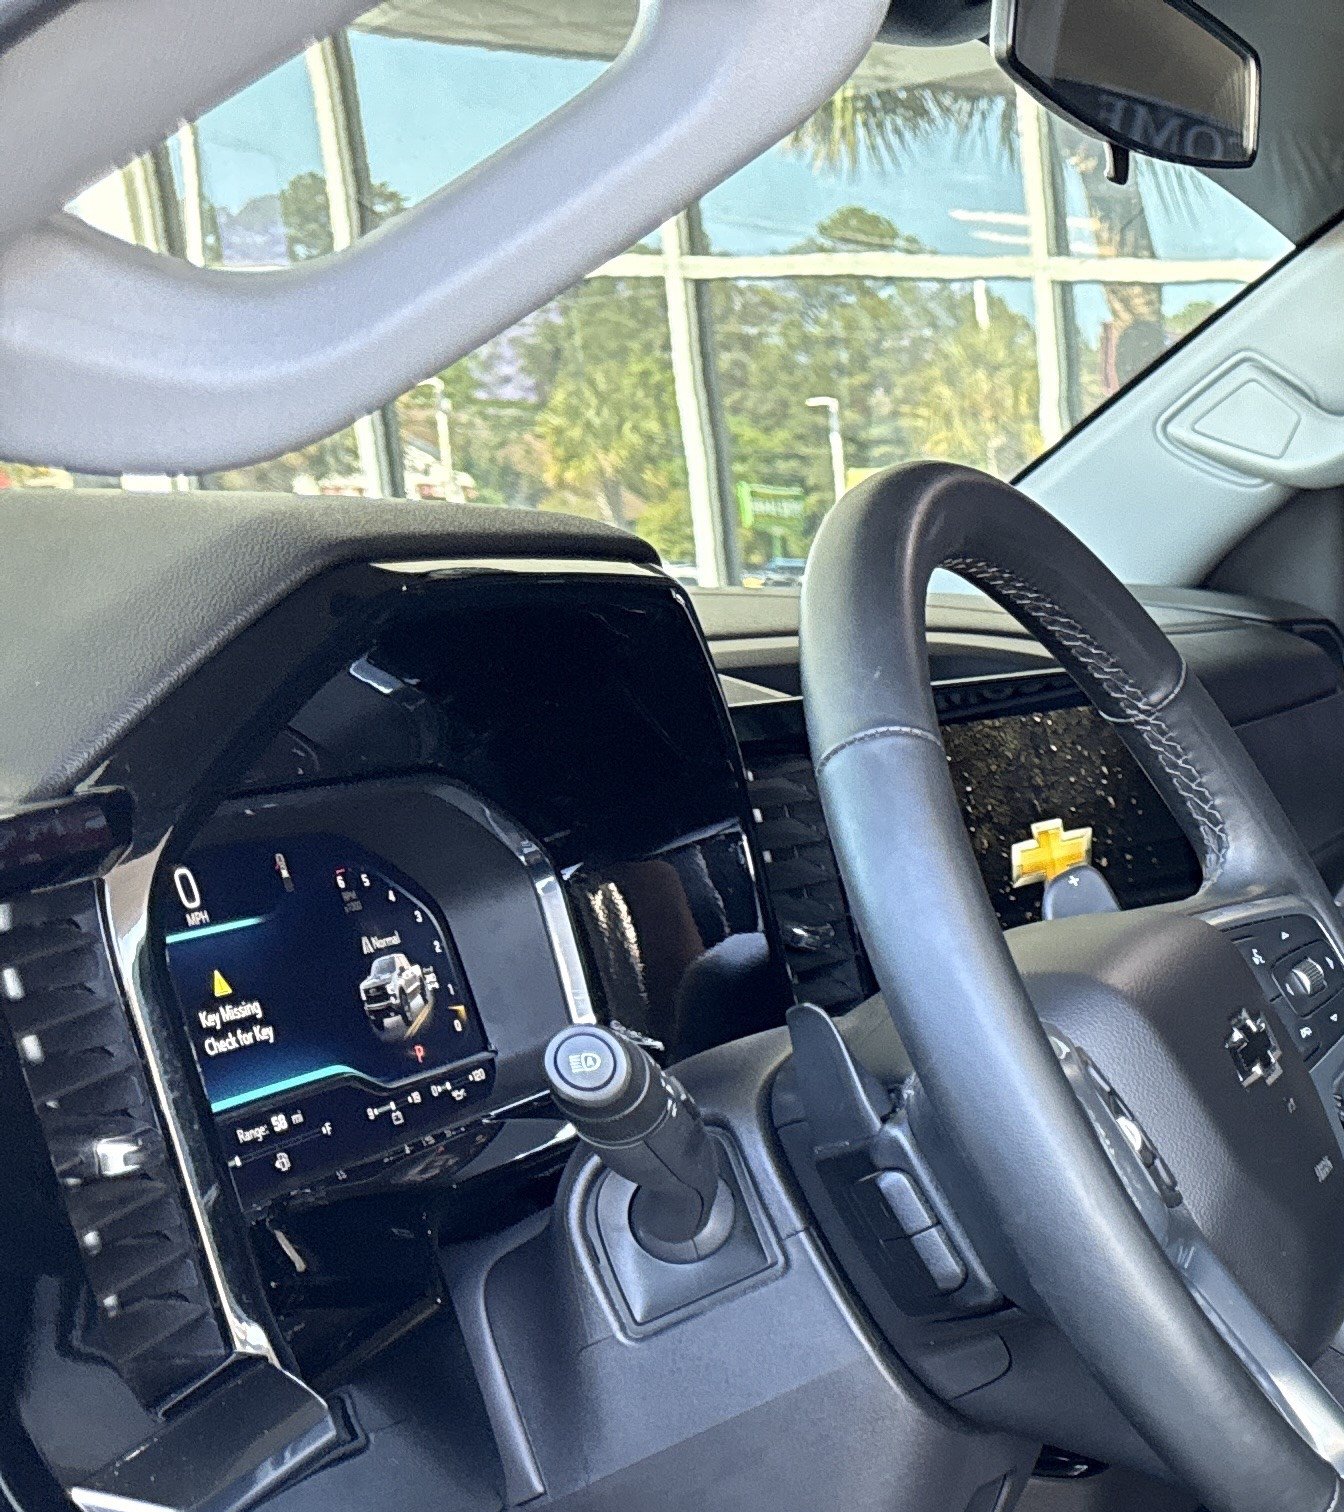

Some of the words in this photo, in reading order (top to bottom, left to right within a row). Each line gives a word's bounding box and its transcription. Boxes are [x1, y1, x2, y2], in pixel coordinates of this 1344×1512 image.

[173, 866, 201, 909] 0
[185, 910, 211, 927] MPH
[198, 1011, 221, 1030] Key
[219, 1001, 263, 1022] Missing
[204, 1032, 240, 1056] Check
[236, 1028, 254, 1047] for
[252, 1025, 274, 1044] Key
[413, 1045, 424, 1063] P
[236, 1124, 270, 1144] Range:
